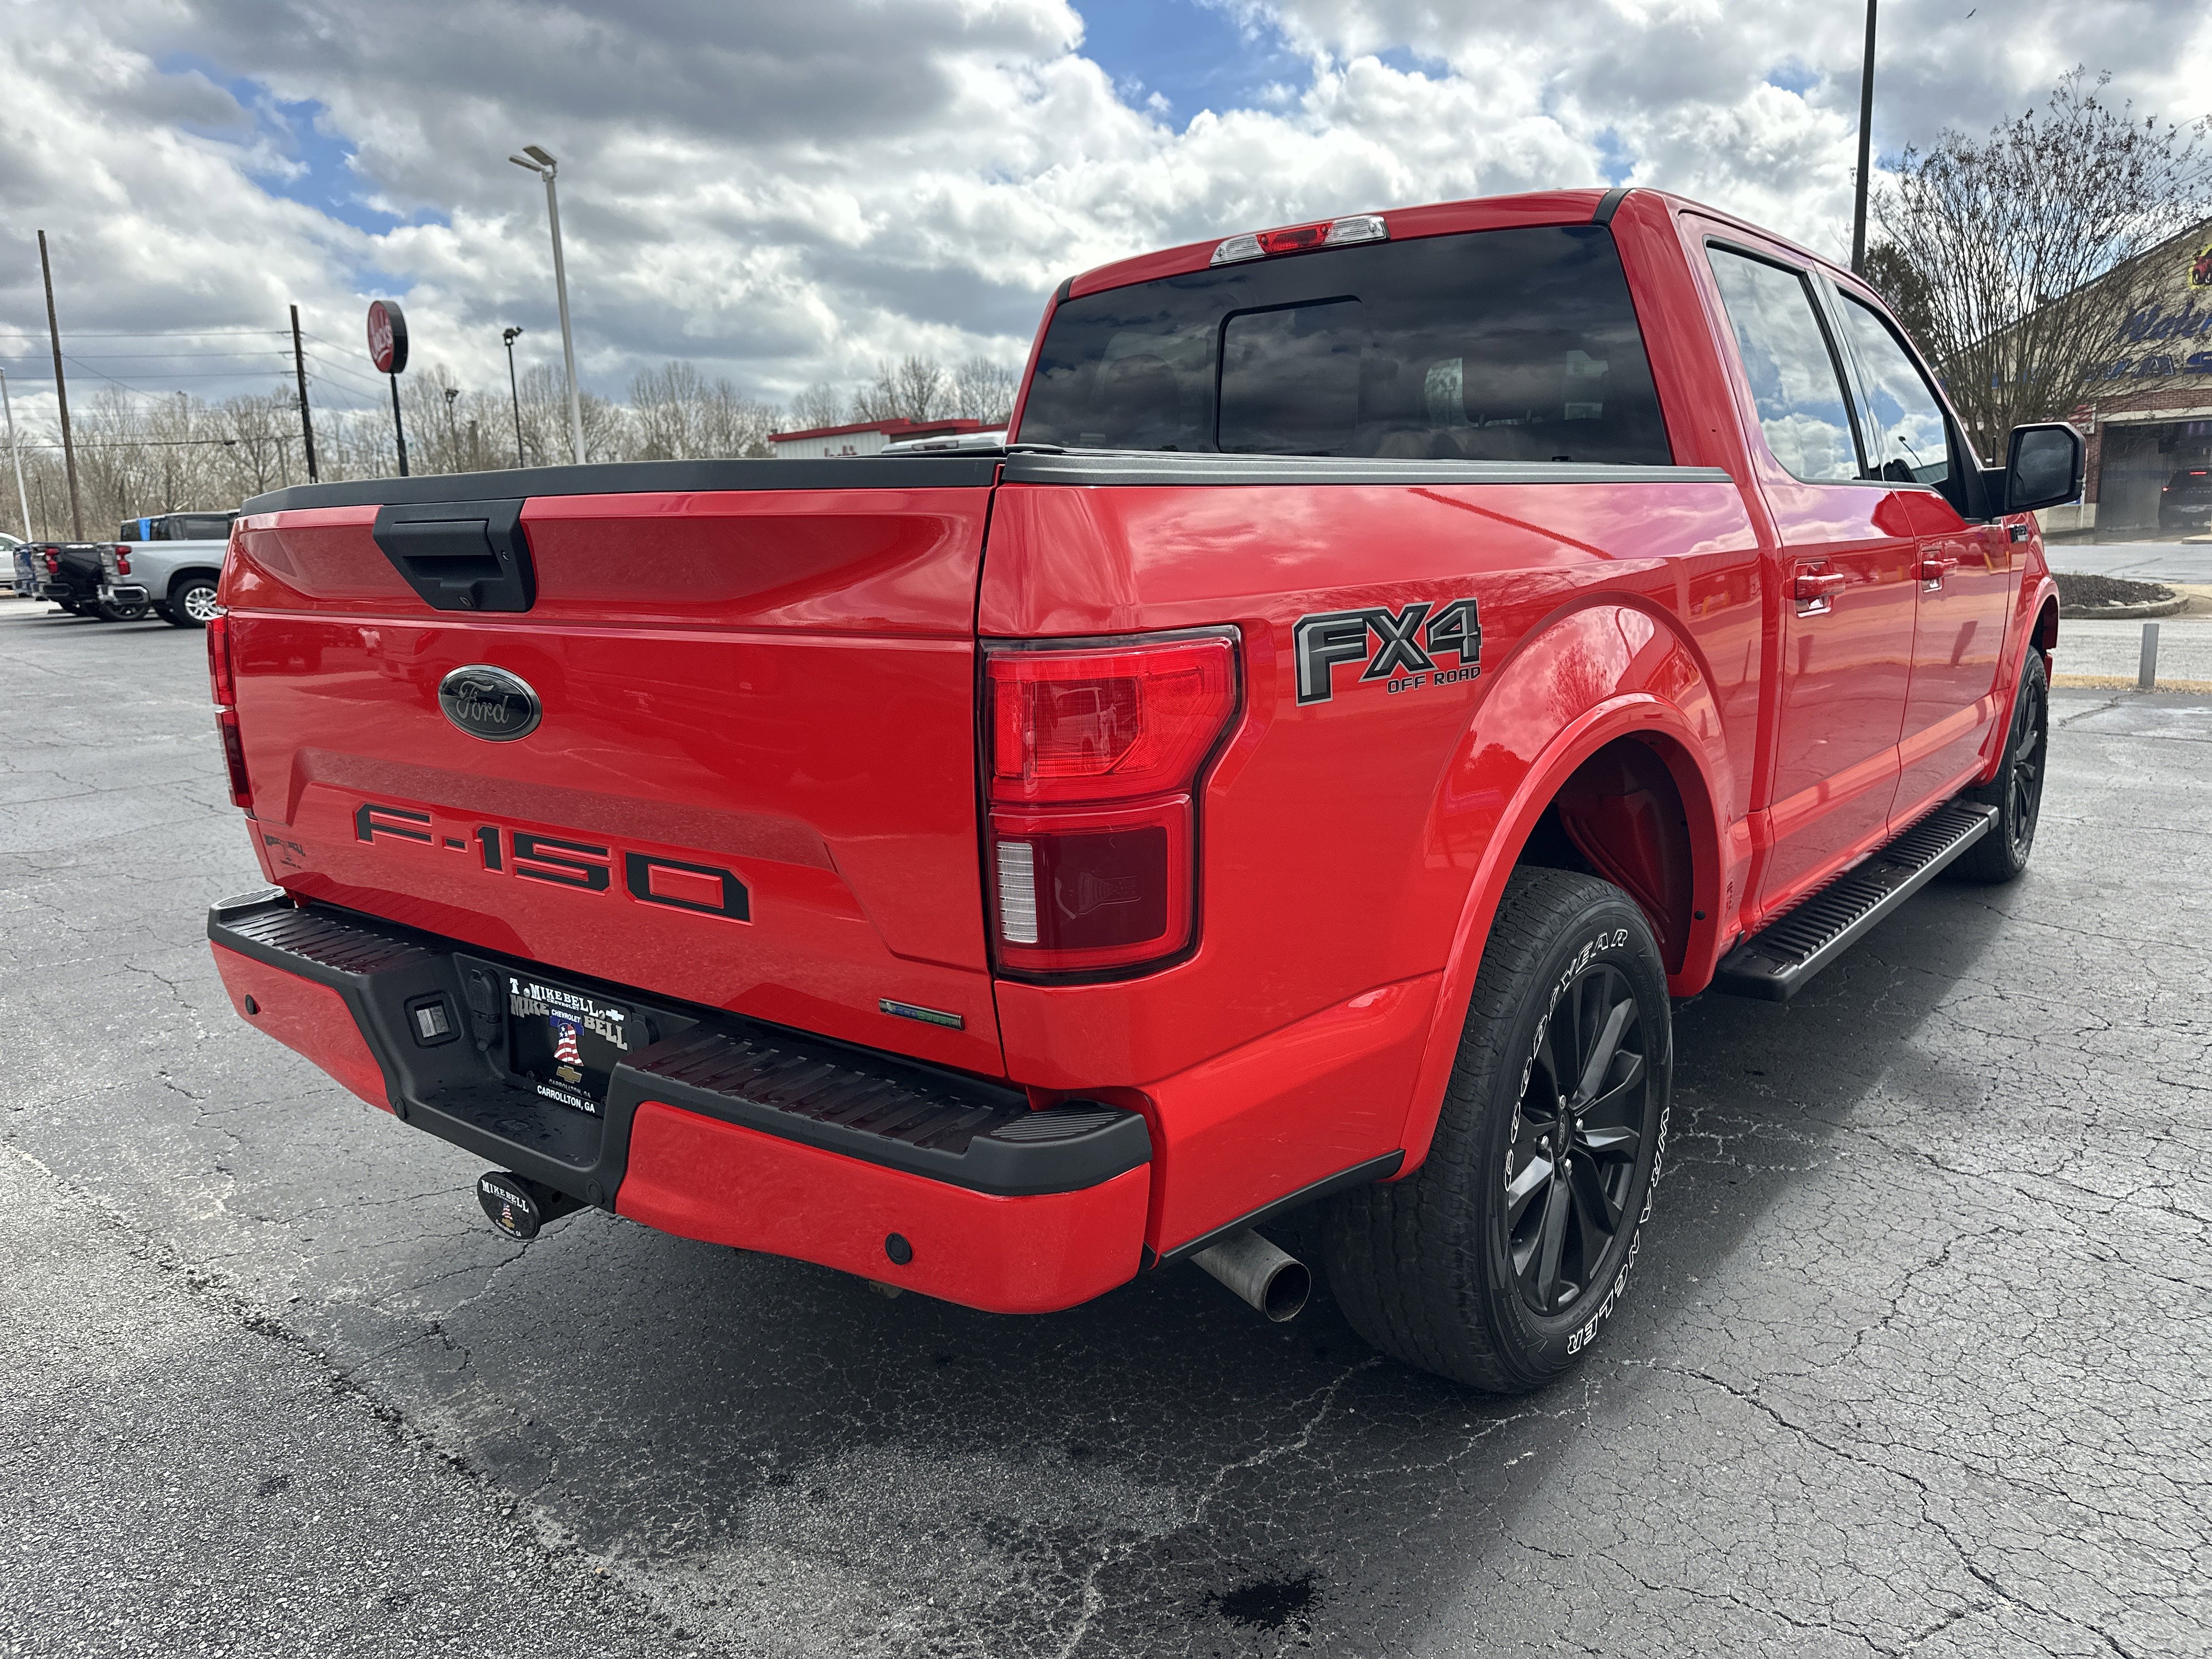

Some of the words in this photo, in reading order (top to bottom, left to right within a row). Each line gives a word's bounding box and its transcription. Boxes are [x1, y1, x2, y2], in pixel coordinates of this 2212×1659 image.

[1292, 597, 1483, 706] FX4
[1387, 675, 1426, 695] OFF
[1434, 665, 1482, 686] ROAD
[456, 681, 510, 724] Ford
[354, 803, 753, 926] F-150
[529, 983, 562, 1001] MIKE
[563, 993, 599, 1018] BELL
[546, 998, 580, 1011] CHEVROLET
[551, 1008, 581, 1023] CHEVROLET
[510, 994, 550, 1018] MIKE
[584, 1015, 628, 1051] BELL
[1504, 928, 1628, 1192] GOODYEAR
[537, 1085, 583, 1110] CARROLLTON,
[584, 1102, 595, 1113] GA
[481, 1179, 506, 1197] MIKE
[505, 1191, 529, 1214] BELL
[1568, 1107, 1669, 1355] WRANGLER
